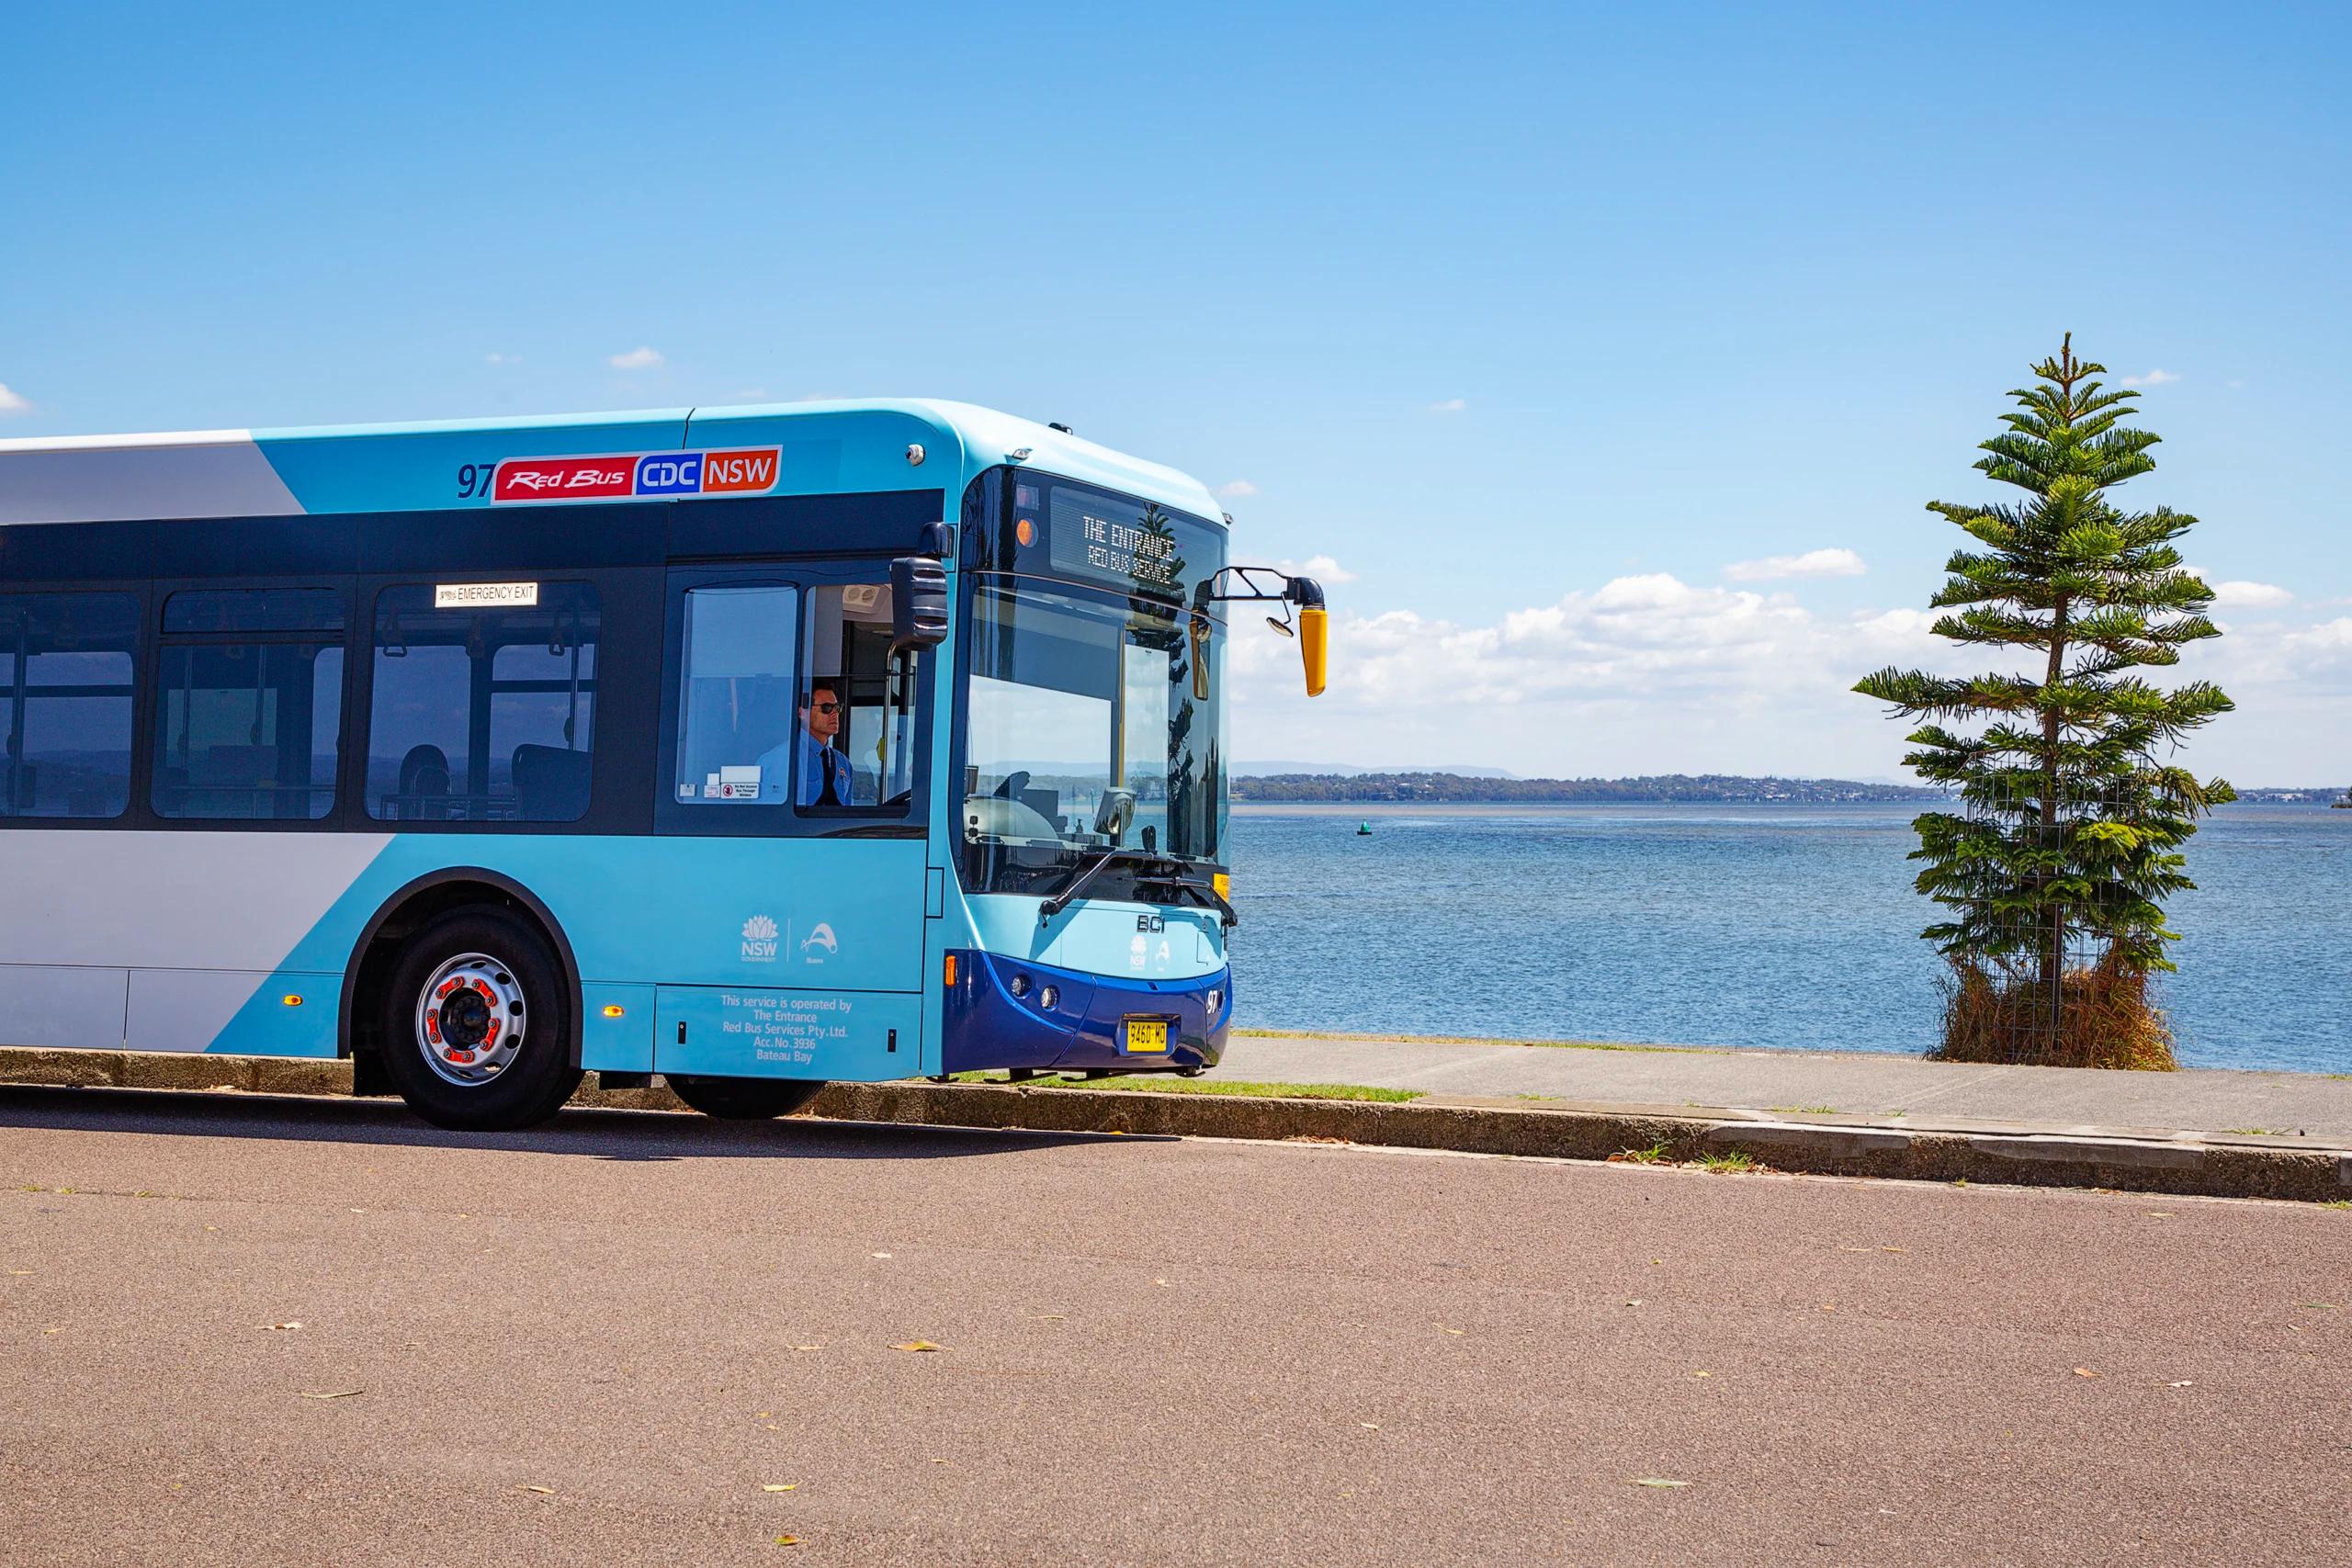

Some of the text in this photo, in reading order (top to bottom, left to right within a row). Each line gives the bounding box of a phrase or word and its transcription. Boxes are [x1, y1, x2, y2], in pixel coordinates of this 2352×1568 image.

[457, 463, 496, 499] 97
[505, 469, 626, 491] Red Bus
[642, 461, 696, 487] CDC
[707, 457, 772, 485] NSW
[1083, 515, 1174, 562] THE ENTRANCE
[1088, 545, 1171, 585] RED BUS SERVICE
[458, 586, 513, 600] EMERGENCY
[514, 585, 534, 599] EXIT
[1136, 915, 1165, 933] BCI
[741, 942, 777, 955] NSW
[720, 994, 853, 1013] This service is operated by
[1207, 989, 1218, 1014] 97
[753, 1009, 817, 1022] The Entrance
[723, 1021, 741, 1032] Red
[745, 1022, 762, 1033] Bus
[764, 1023, 805, 1035] Services
[756, 1049, 812, 1065] Bateau Bay
